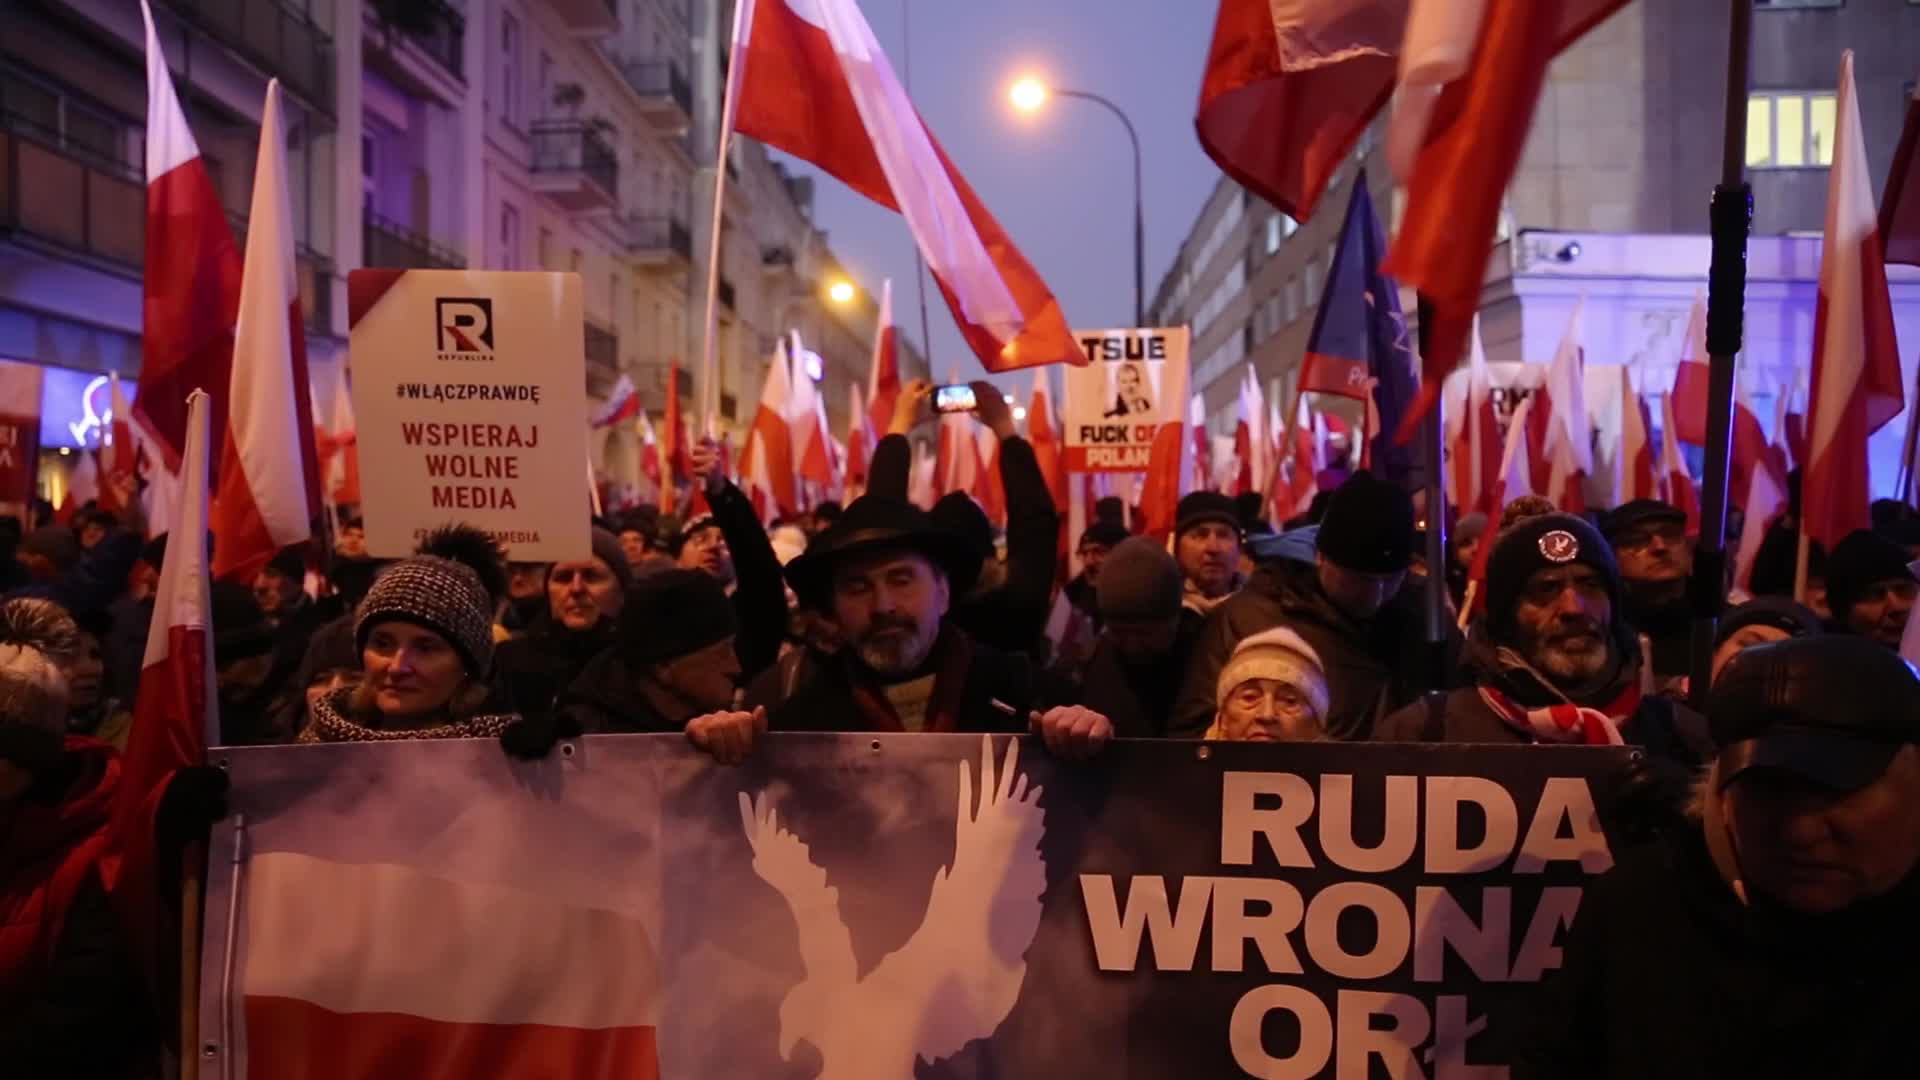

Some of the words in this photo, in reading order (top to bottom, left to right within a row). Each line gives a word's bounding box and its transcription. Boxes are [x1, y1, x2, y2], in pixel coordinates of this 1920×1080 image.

[1082, 336, 1165, 360] TSUE
[397, 383, 540, 405] #WŁĄCZPRAWDĘ
[402, 422, 538, 448] WSPIERAJ
[1081, 425, 1129, 443] FUCK
[426, 454, 519, 478] WOLNE
[1087, 447, 1150, 468] POLAN
[432, 485, 516, 509] MEDIA
[1221, 770, 1615, 874] RUDA
[1079, 874, 1583, 982] WRONA
[1229, 984, 1511, 1080] ORŁ
